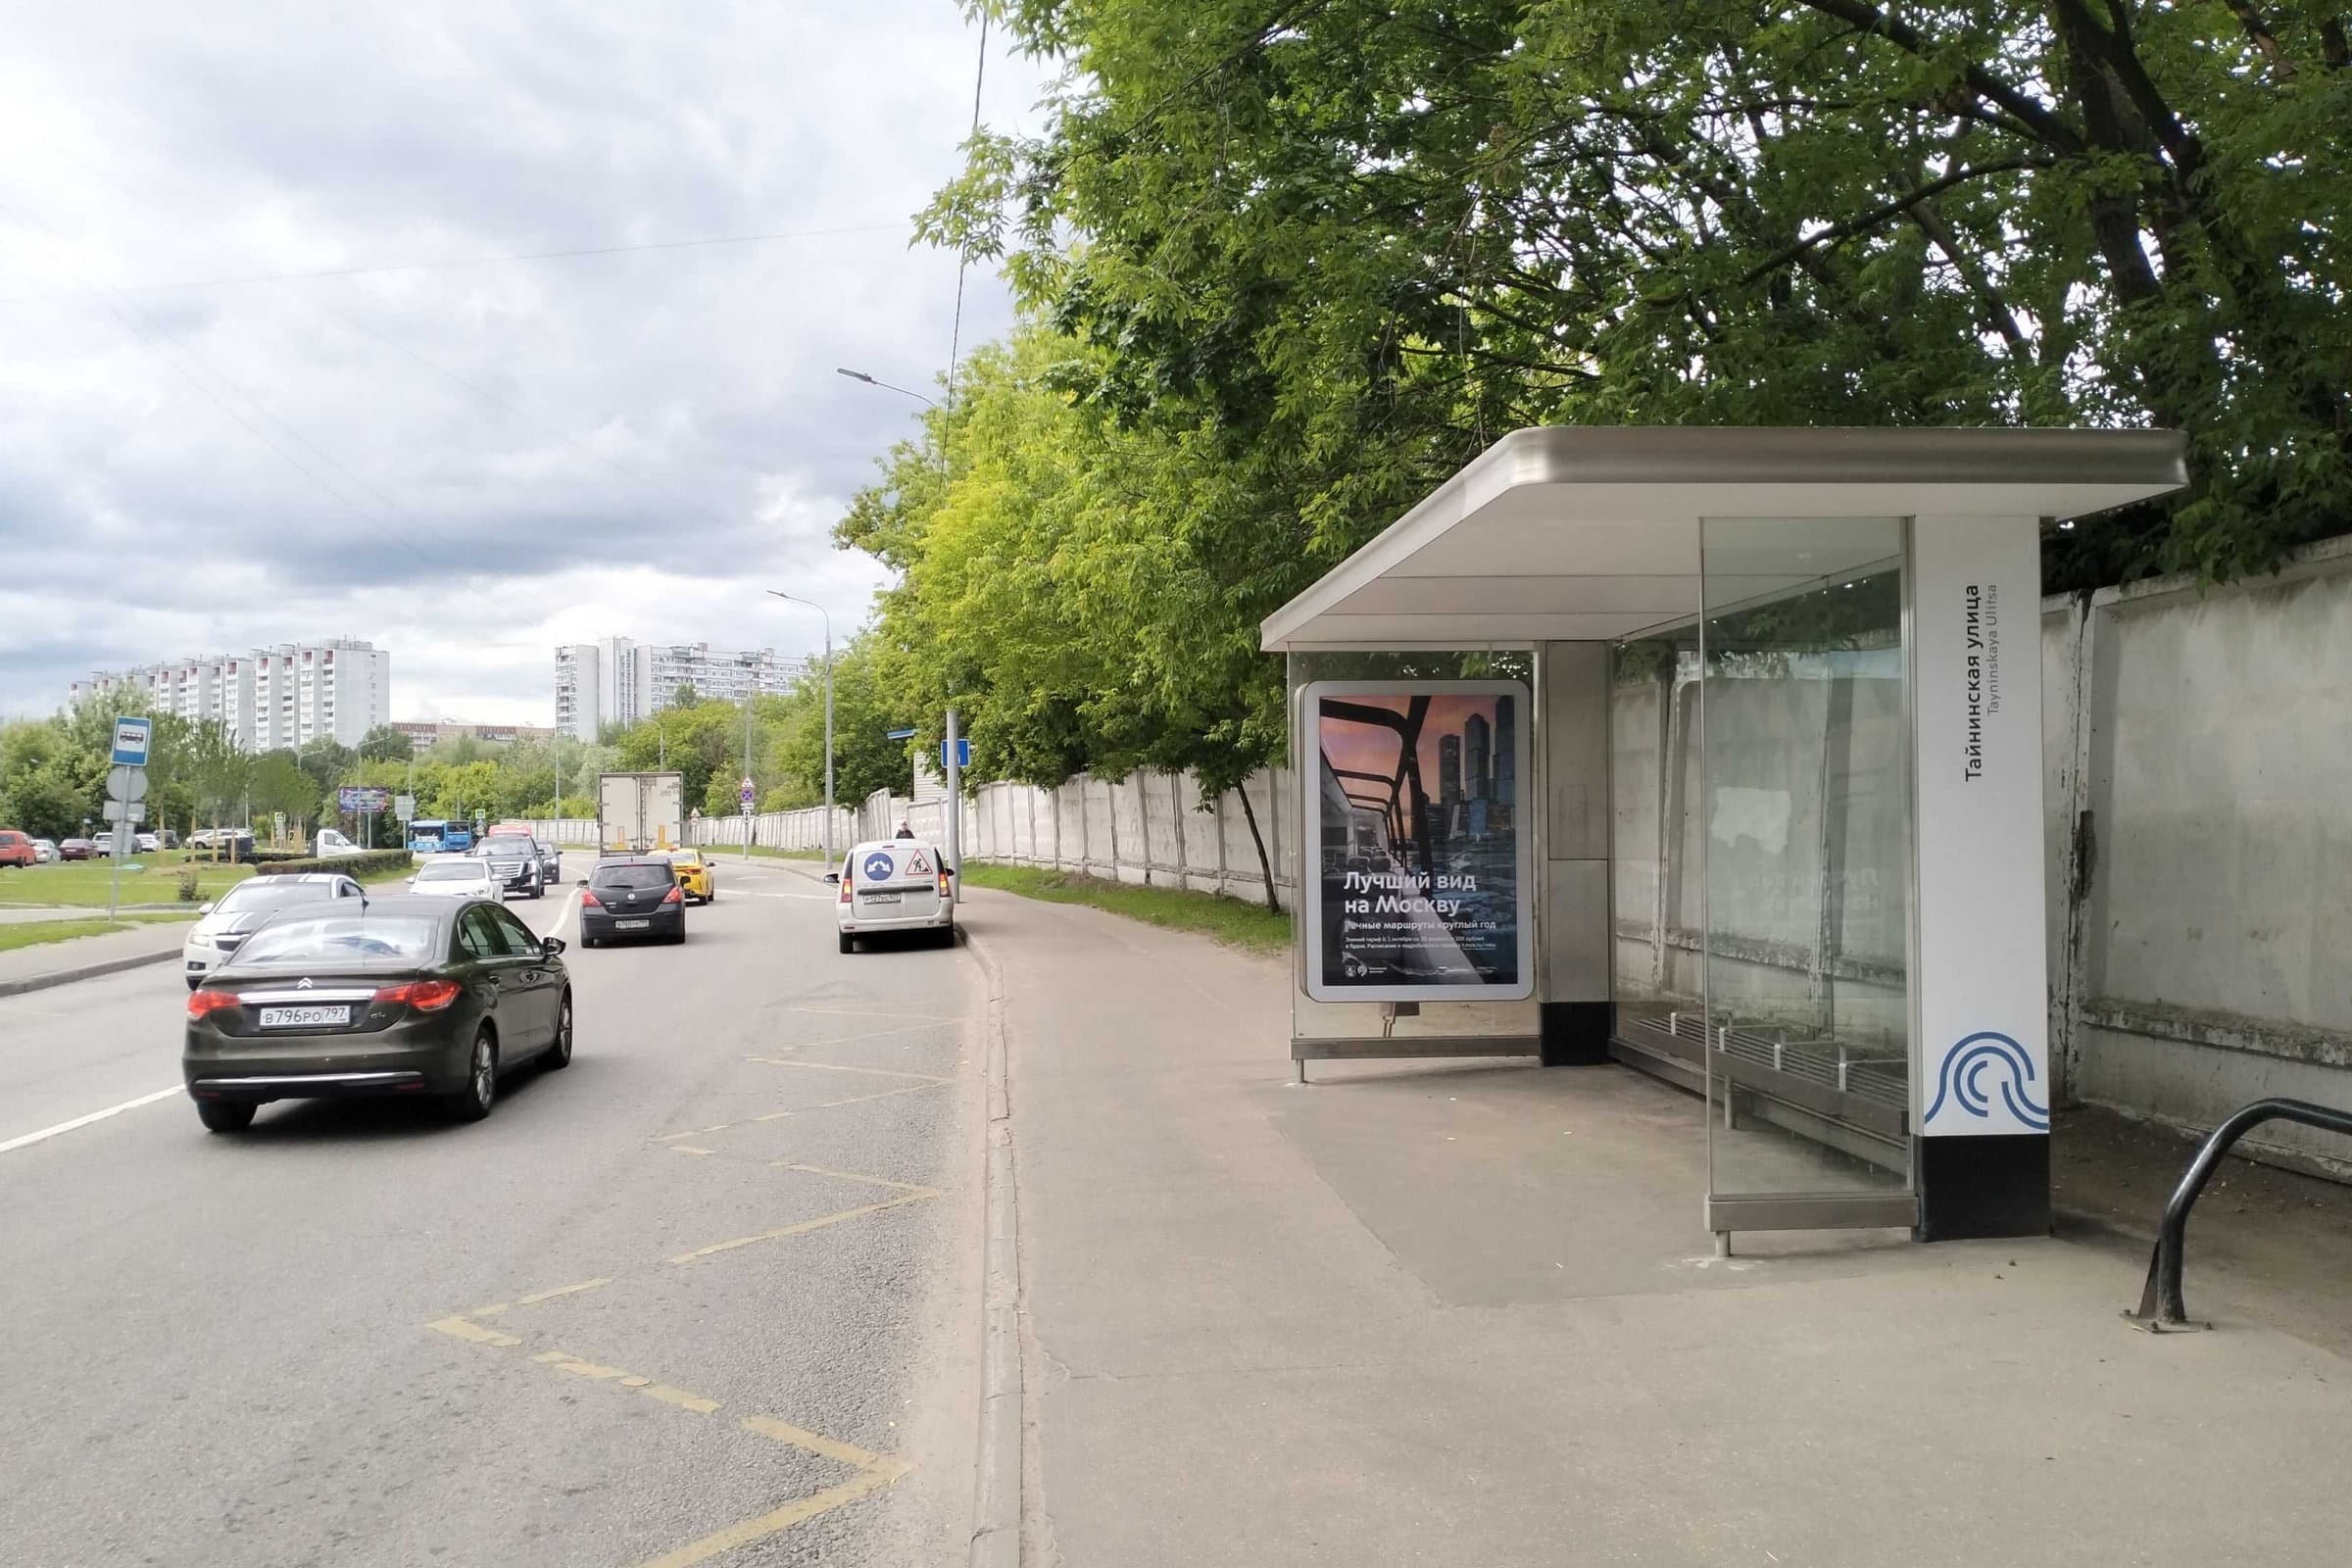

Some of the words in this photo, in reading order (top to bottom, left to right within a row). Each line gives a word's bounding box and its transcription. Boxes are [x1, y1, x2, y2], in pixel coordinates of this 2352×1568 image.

[1965, 584, 1984, 649] улица
[1985, 584, 1997, 626] Ulitsa
[1985, 630, 2001, 715] Tayninskaya
[1964, 655, 1982, 782] Тайнинская
[1344, 871, 1431, 894] Лучший
[1437, 874, 1477, 892] вид
[1345, 900, 1369, 913] на
[1375, 895, 1460, 917] Москву
[1345, 920, 1381, 930] Речные
[1383, 921, 1434, 931] маршруты
[1437, 919, 1478, 931] круглый
[1480, 921, 1496, 930] год
[322, 1006, 346, 1020] 797
